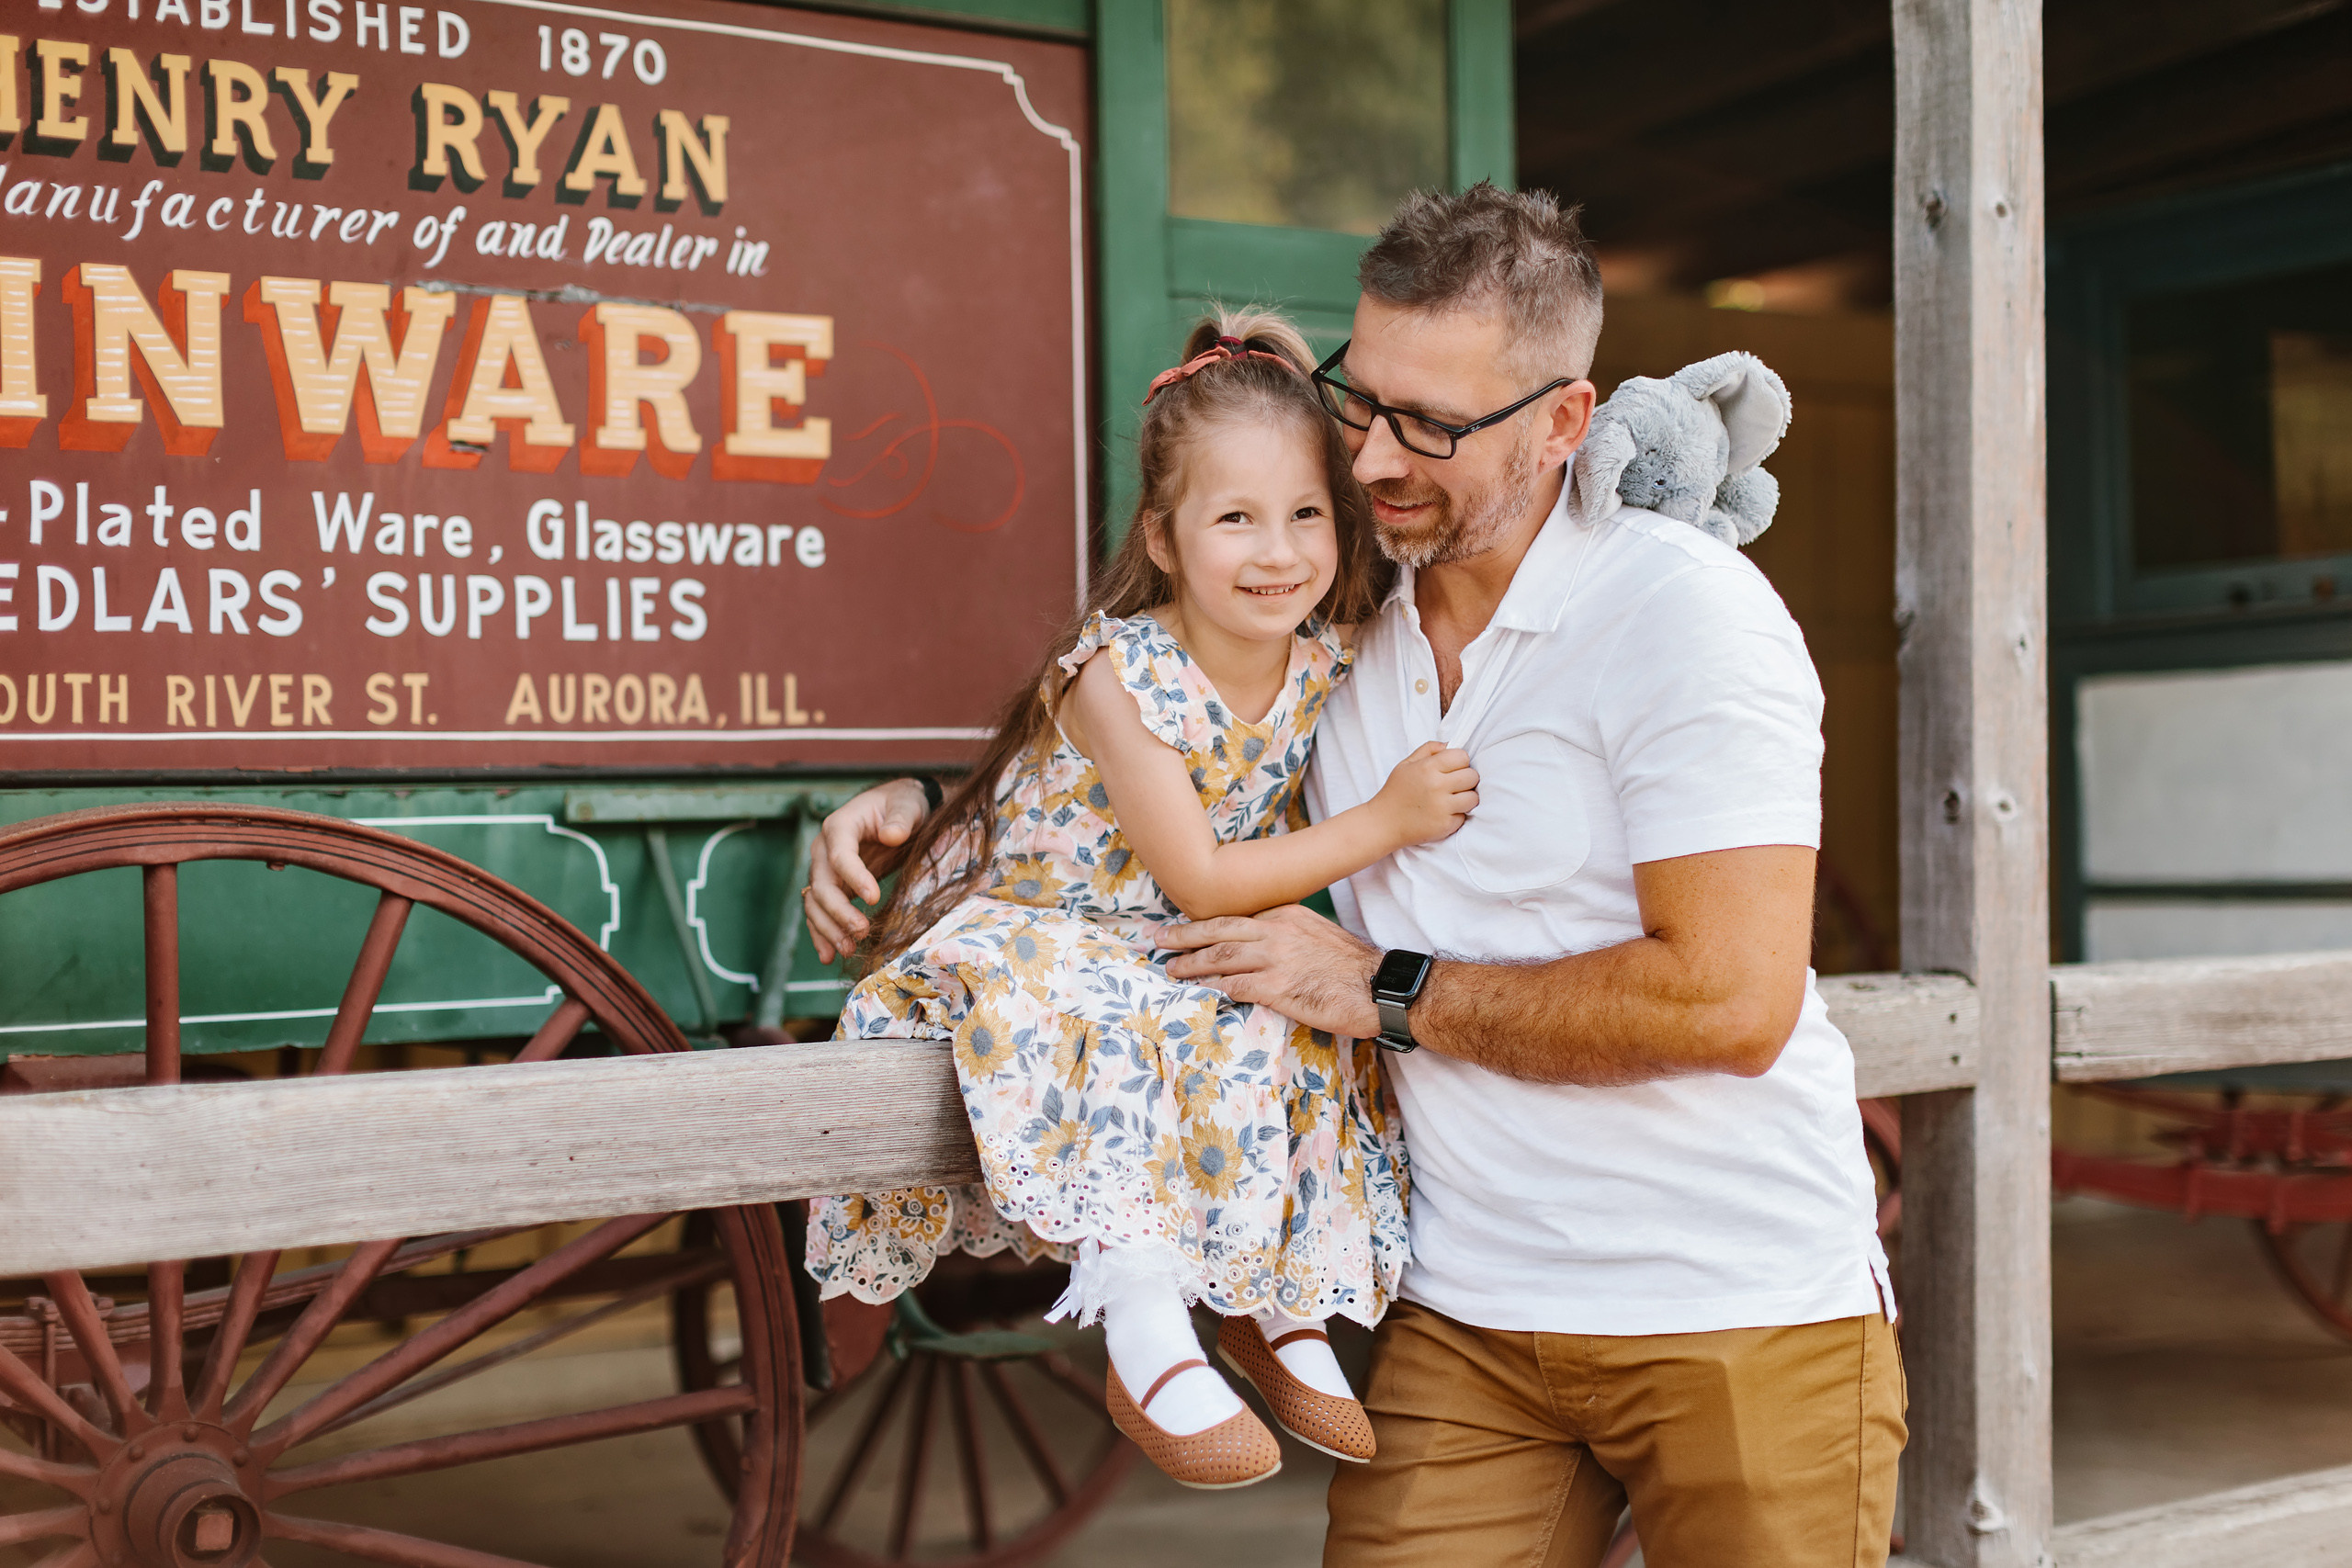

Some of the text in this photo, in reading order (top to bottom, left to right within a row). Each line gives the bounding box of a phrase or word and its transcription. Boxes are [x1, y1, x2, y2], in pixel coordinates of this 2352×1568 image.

[539, 25, 667, 85] 1870
[0, 34, 730, 204] ENRY RYAN
[0, 164, 770, 277] anufacturer of and Dealer in
[311, 491, 503, 564] Ware,
[526, 498, 827, 568] Glassware
[365, 570, 709, 642] SUPPLIES
[166, 673, 334, 728] RIVER
[366, 672, 438, 726] ST.
[740, 671, 826, 726] ILL.
